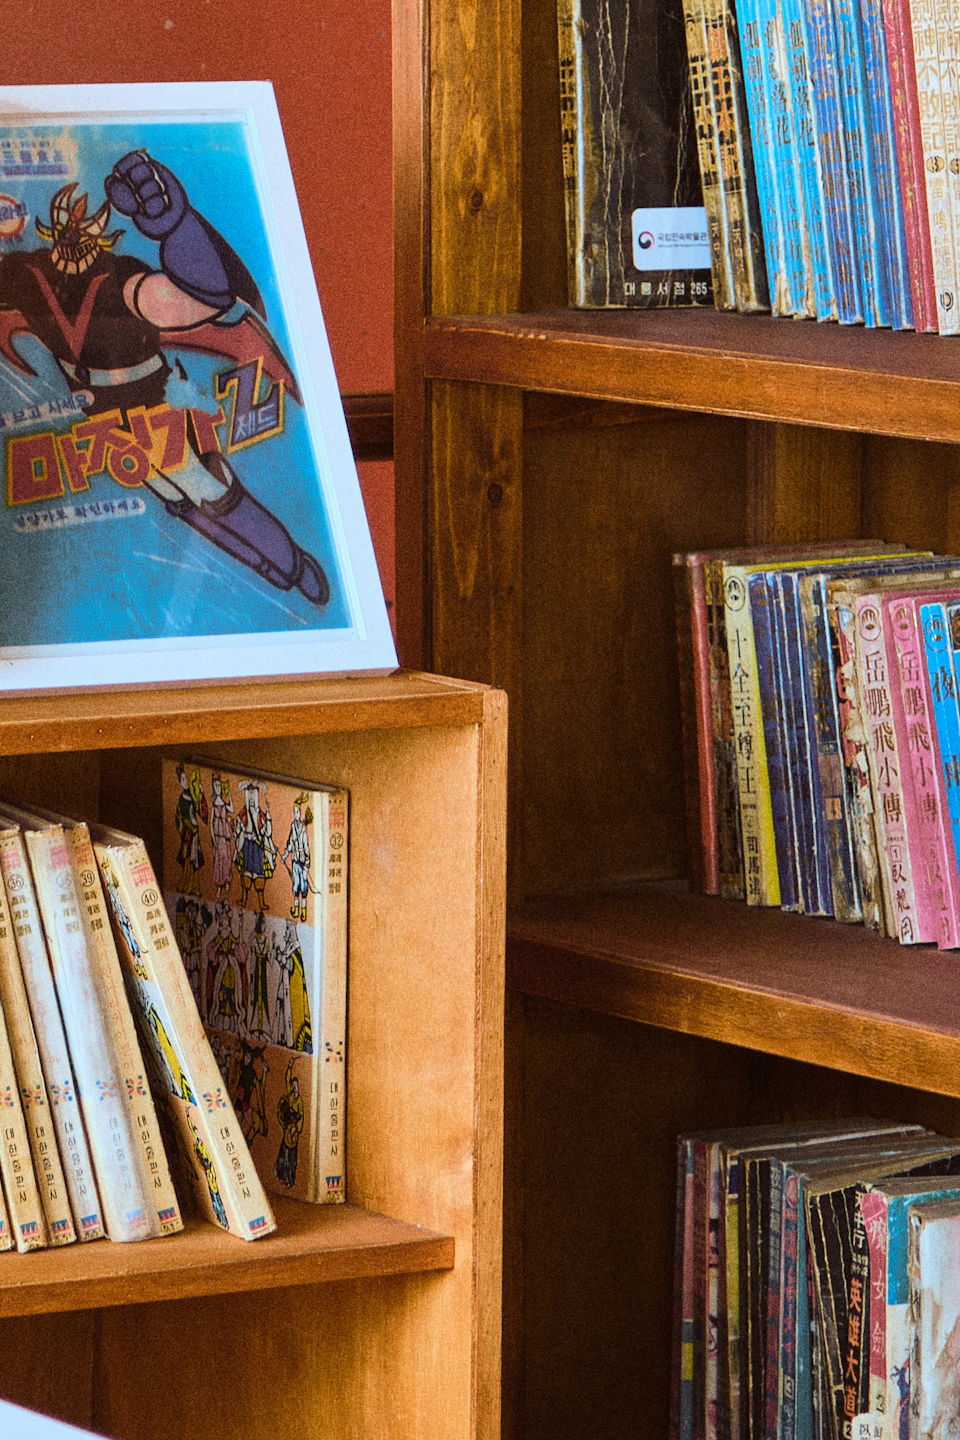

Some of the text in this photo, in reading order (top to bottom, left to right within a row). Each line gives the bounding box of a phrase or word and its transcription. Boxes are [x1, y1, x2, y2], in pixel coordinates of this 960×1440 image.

[48, 393, 90, 414] 사세요
[215, 356, 285, 456] Z
[234, 403, 278, 442] 제드
[6, 402, 227, 508] 마징가
